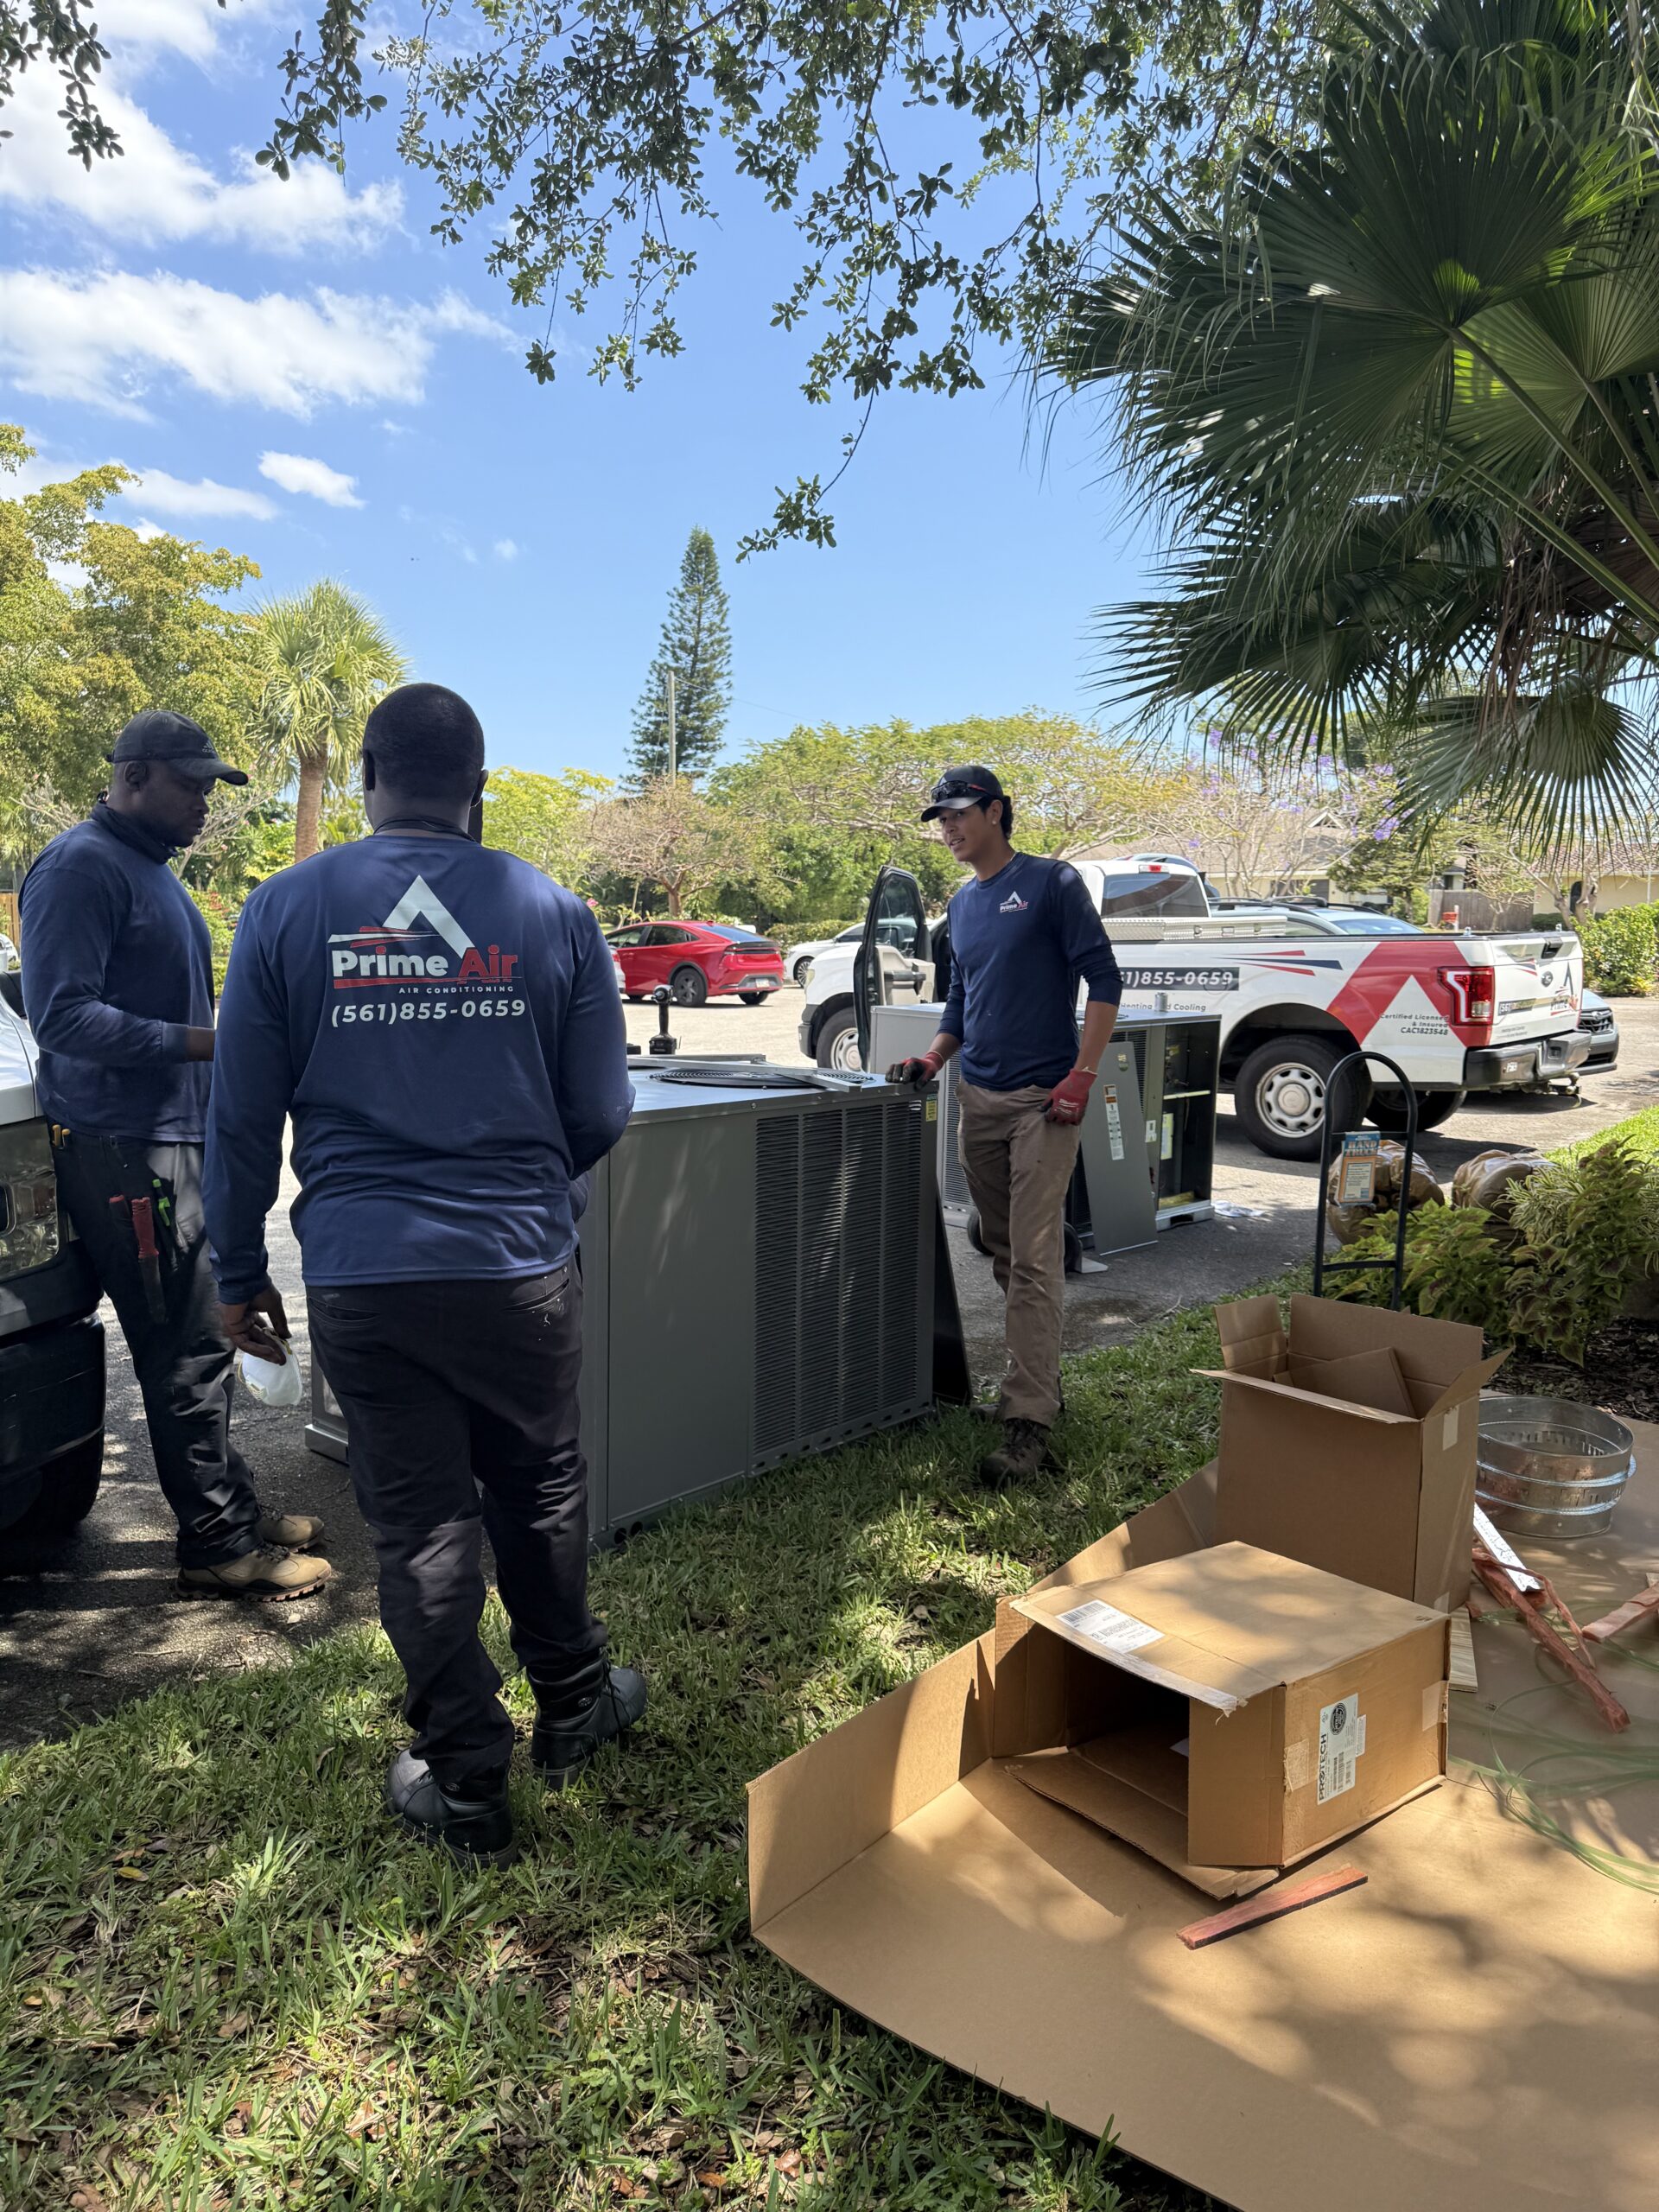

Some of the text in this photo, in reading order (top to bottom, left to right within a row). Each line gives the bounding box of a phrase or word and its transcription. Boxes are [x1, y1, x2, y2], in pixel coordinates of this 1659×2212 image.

[331, 944, 518, 984] Prime Air
[426, 986, 515, 995] CONDITIONING
[331, 999, 526, 1027] (561)855-0659
[1173, 1003, 1206, 1013] Cooling
[1319, 1733, 1327, 1801] PROTECH
